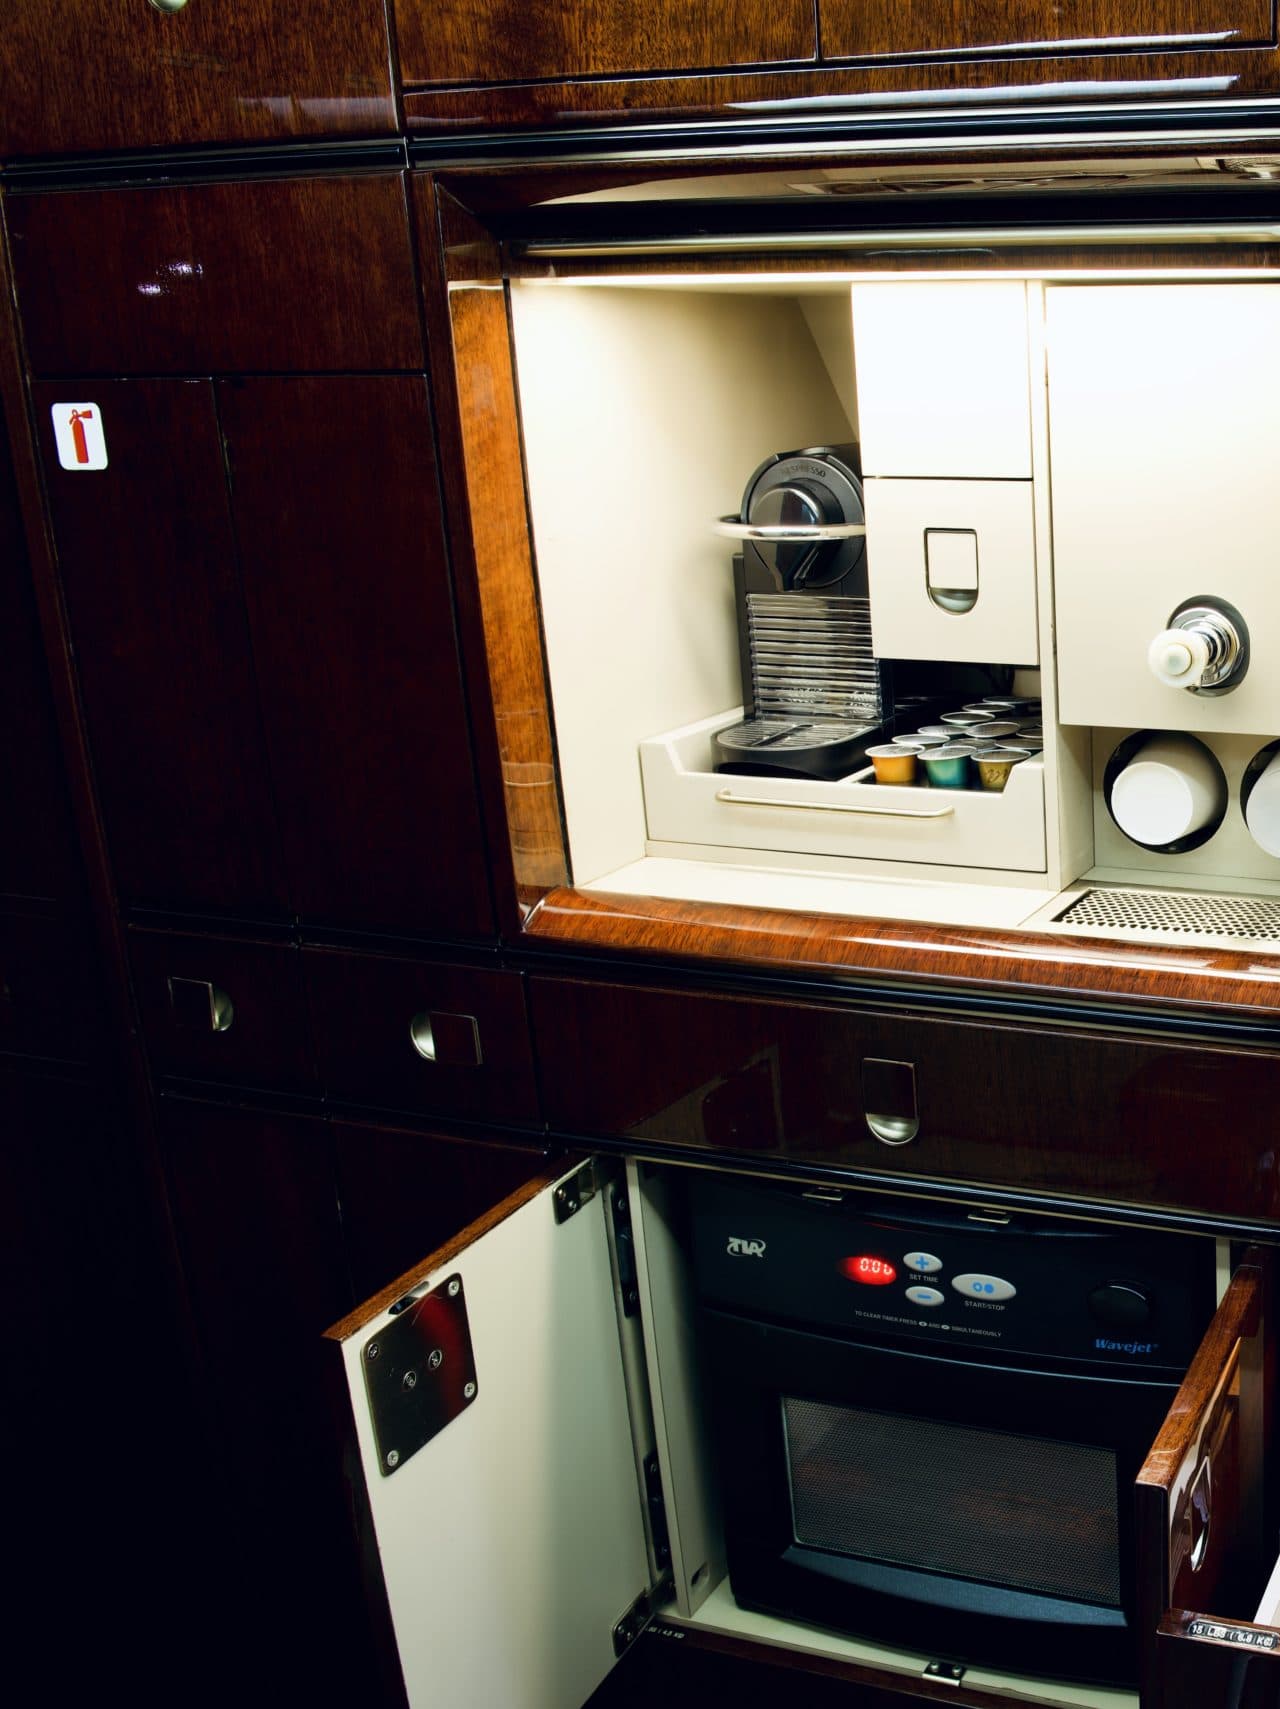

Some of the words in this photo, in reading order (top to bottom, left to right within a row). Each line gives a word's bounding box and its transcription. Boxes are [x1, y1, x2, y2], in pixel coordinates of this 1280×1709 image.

[909, 1273, 922, 1281] SET
[923, 1275, 939, 1283] TIME
[964, 1300, 1006, 1311] START/STOP
[1095, 1338, 1153, 1355] Wavejet
